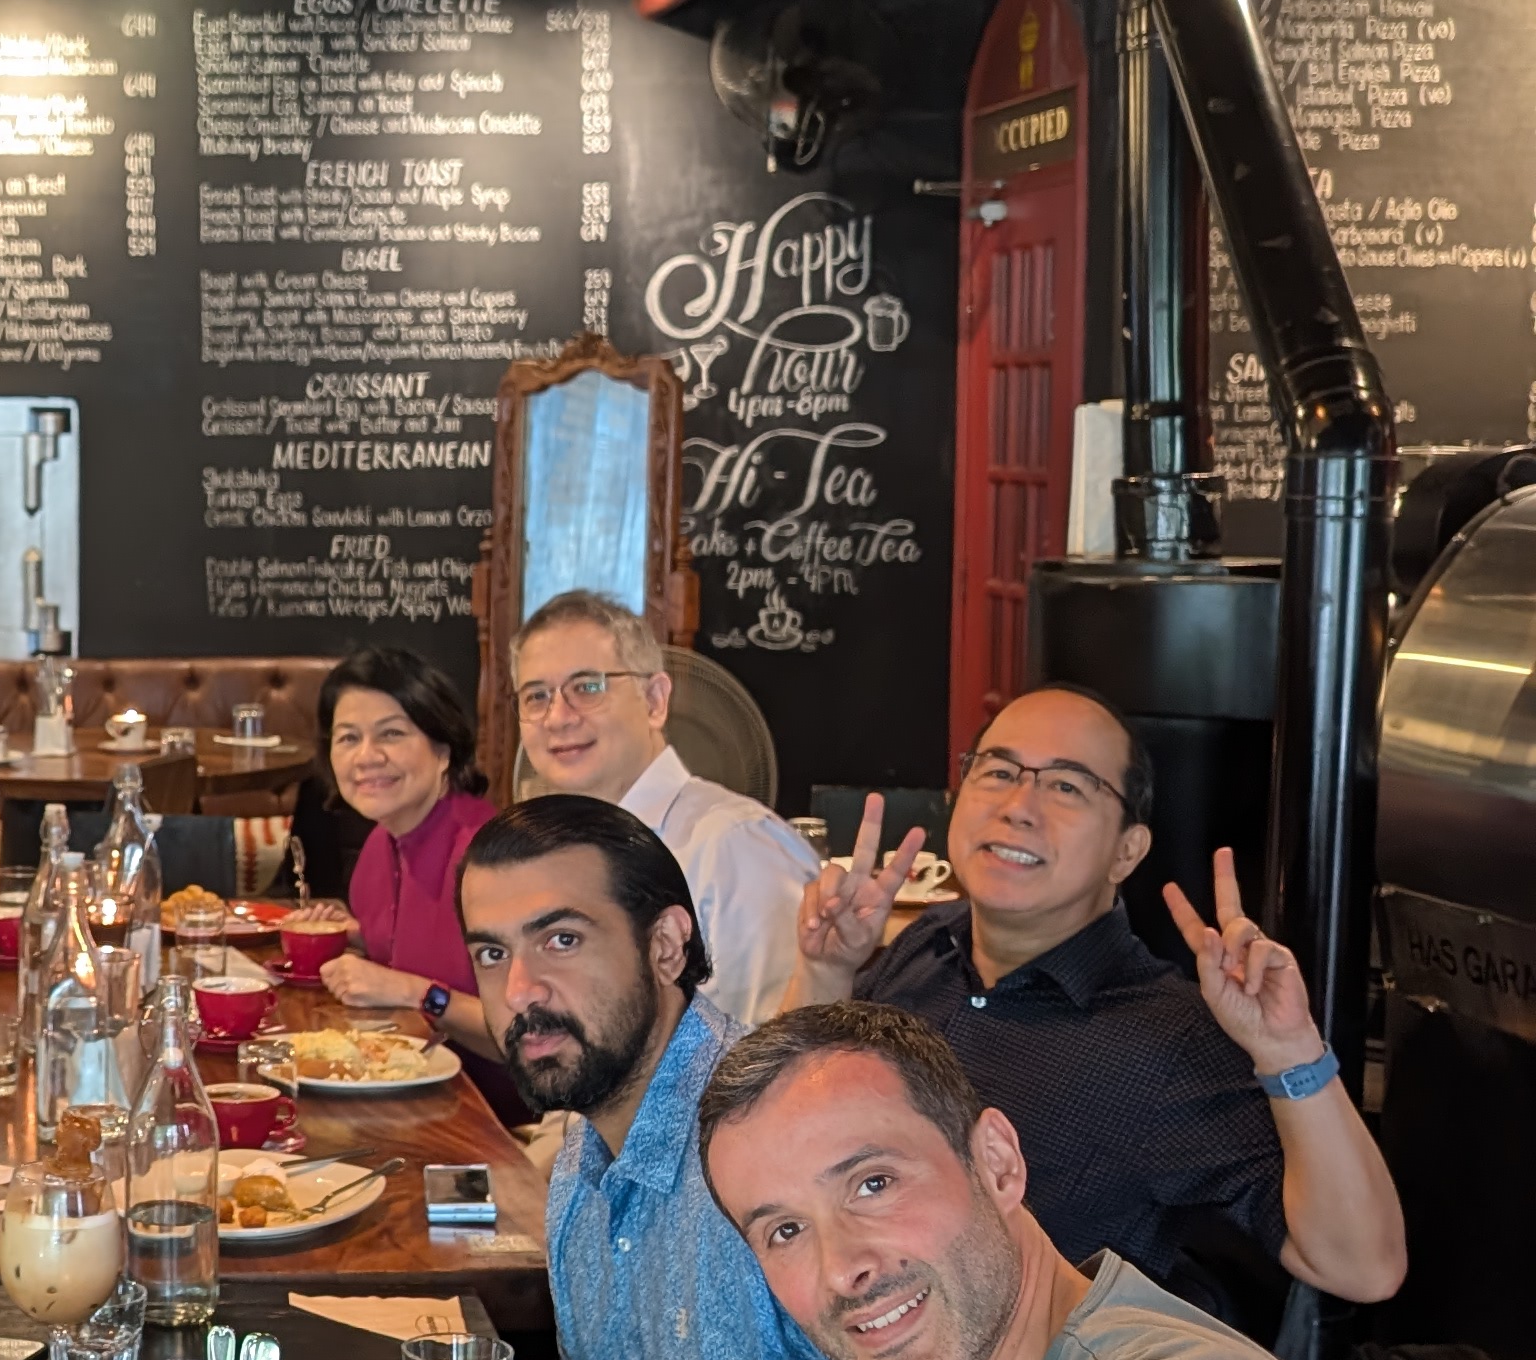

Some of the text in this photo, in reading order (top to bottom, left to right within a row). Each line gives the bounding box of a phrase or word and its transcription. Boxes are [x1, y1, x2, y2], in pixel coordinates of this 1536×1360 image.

[1366, 15, 1408, 40] Pizza
[1392, 40, 1436, 62] Pizza
[1399, 61, 1442, 84] Pizza
[1367, 82, 1409, 107] Pizza
[994, 104, 1070, 154] CCUPIED
[1371, 106, 1413, 129] Pizza
[1338, 131, 1381, 152] Pizza
[306, 158, 465, 188] FRENCH TOAST
[341, 246, 404, 273] BAGEL
[645, 191, 873, 340] Happy
[306, 372, 431, 400] CROISSANT
[272, 440, 492, 470] MEDITERRANEAN
[764, 422, 887, 520] Tea
[330, 534, 391, 560] FRIED
[744, 520, 854, 566] Coffee
[726, 560, 776, 598] 2pm
[1407, 926, 1458, 978] HAS
